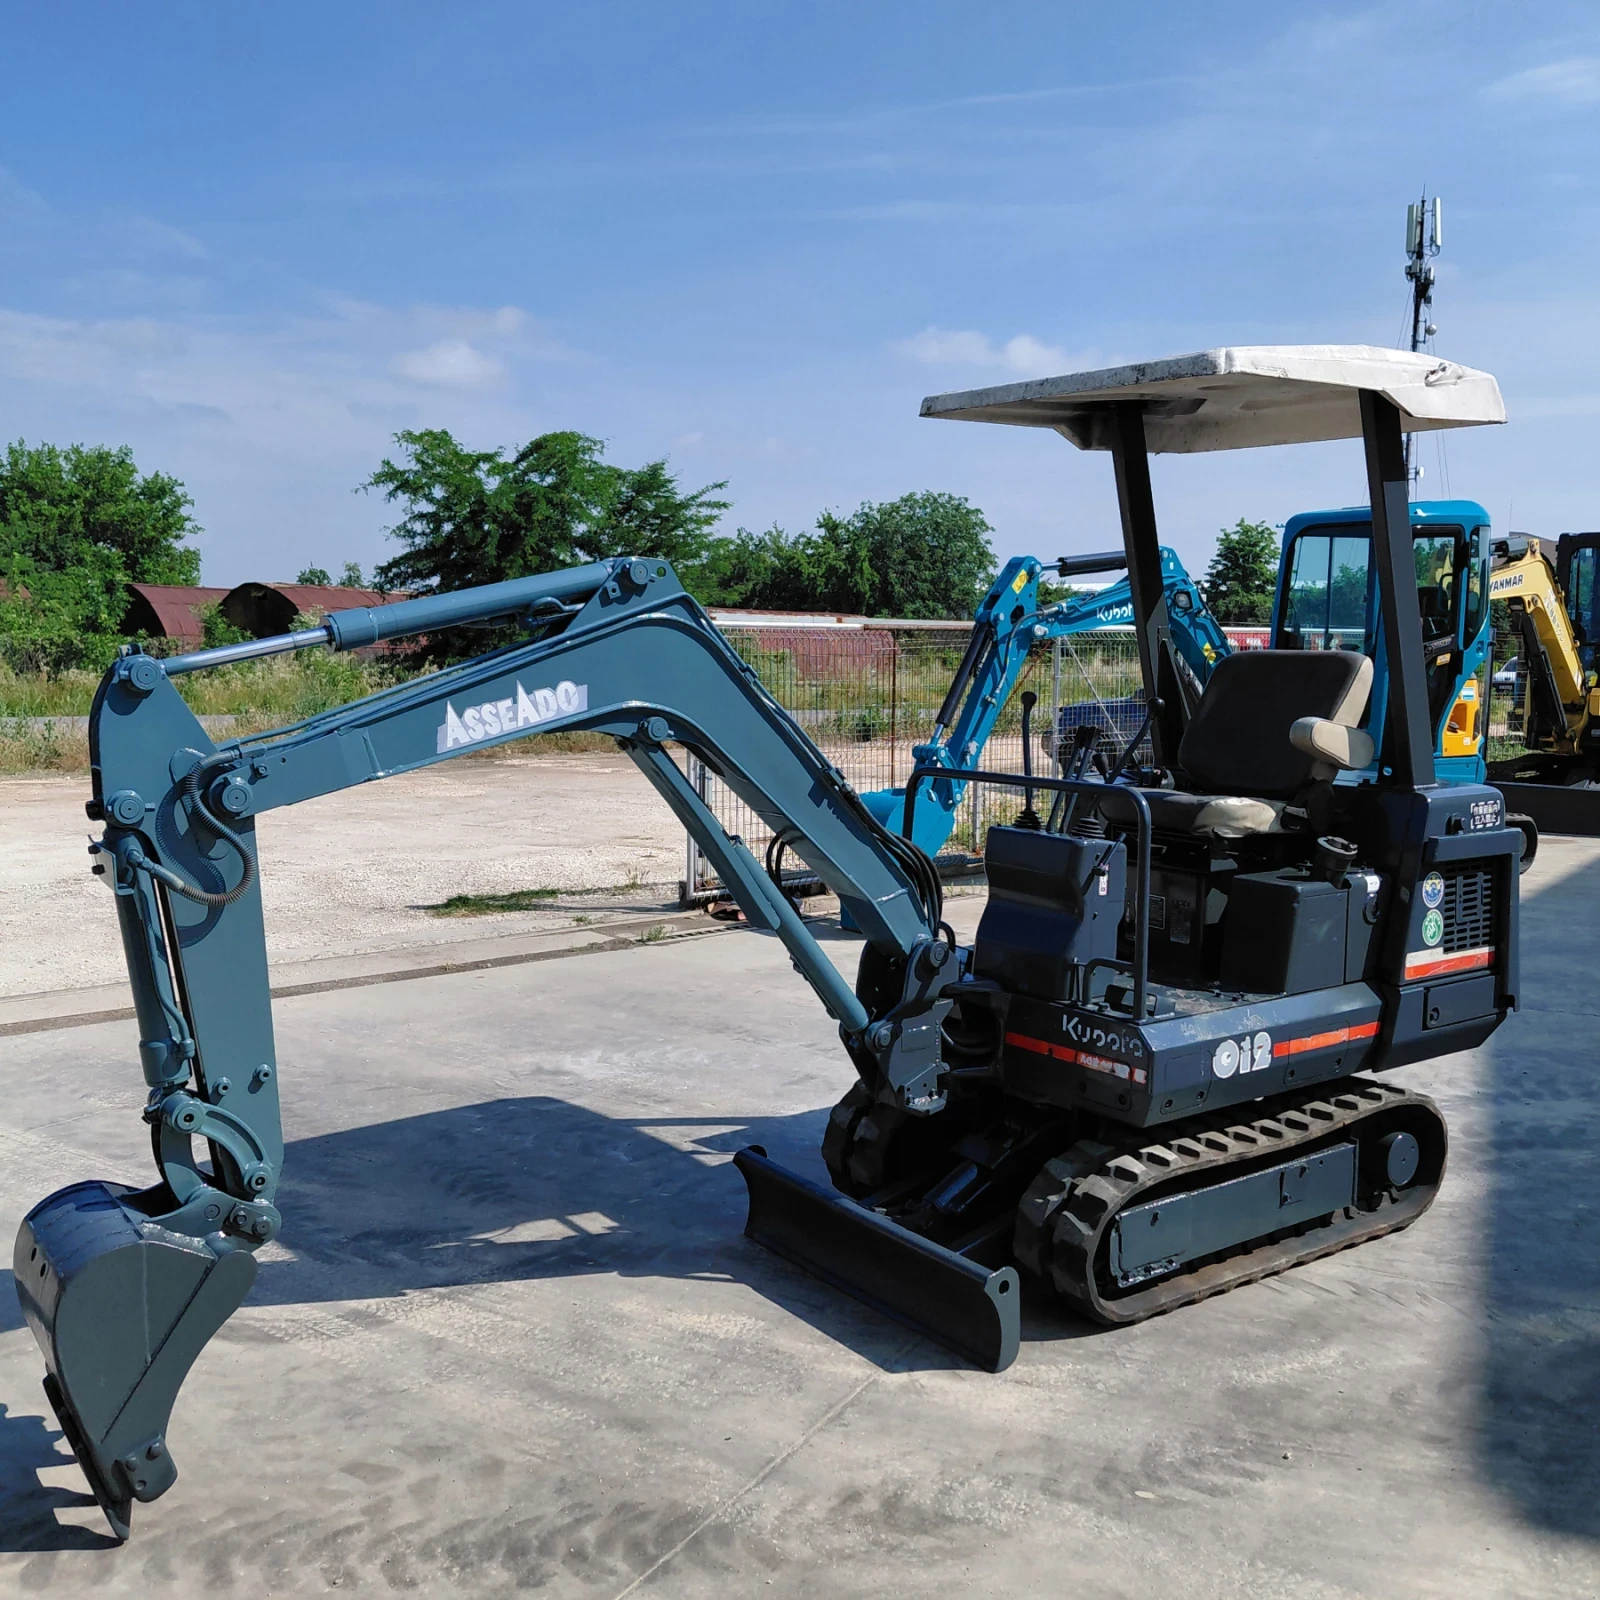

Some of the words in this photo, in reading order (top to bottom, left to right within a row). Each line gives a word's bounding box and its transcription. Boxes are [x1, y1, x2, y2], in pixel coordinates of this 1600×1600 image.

[1097, 602, 1134, 621] Kubot
[446, 680, 581, 748] ASSEADO
[1062, 1014, 1144, 1058] Kubota
